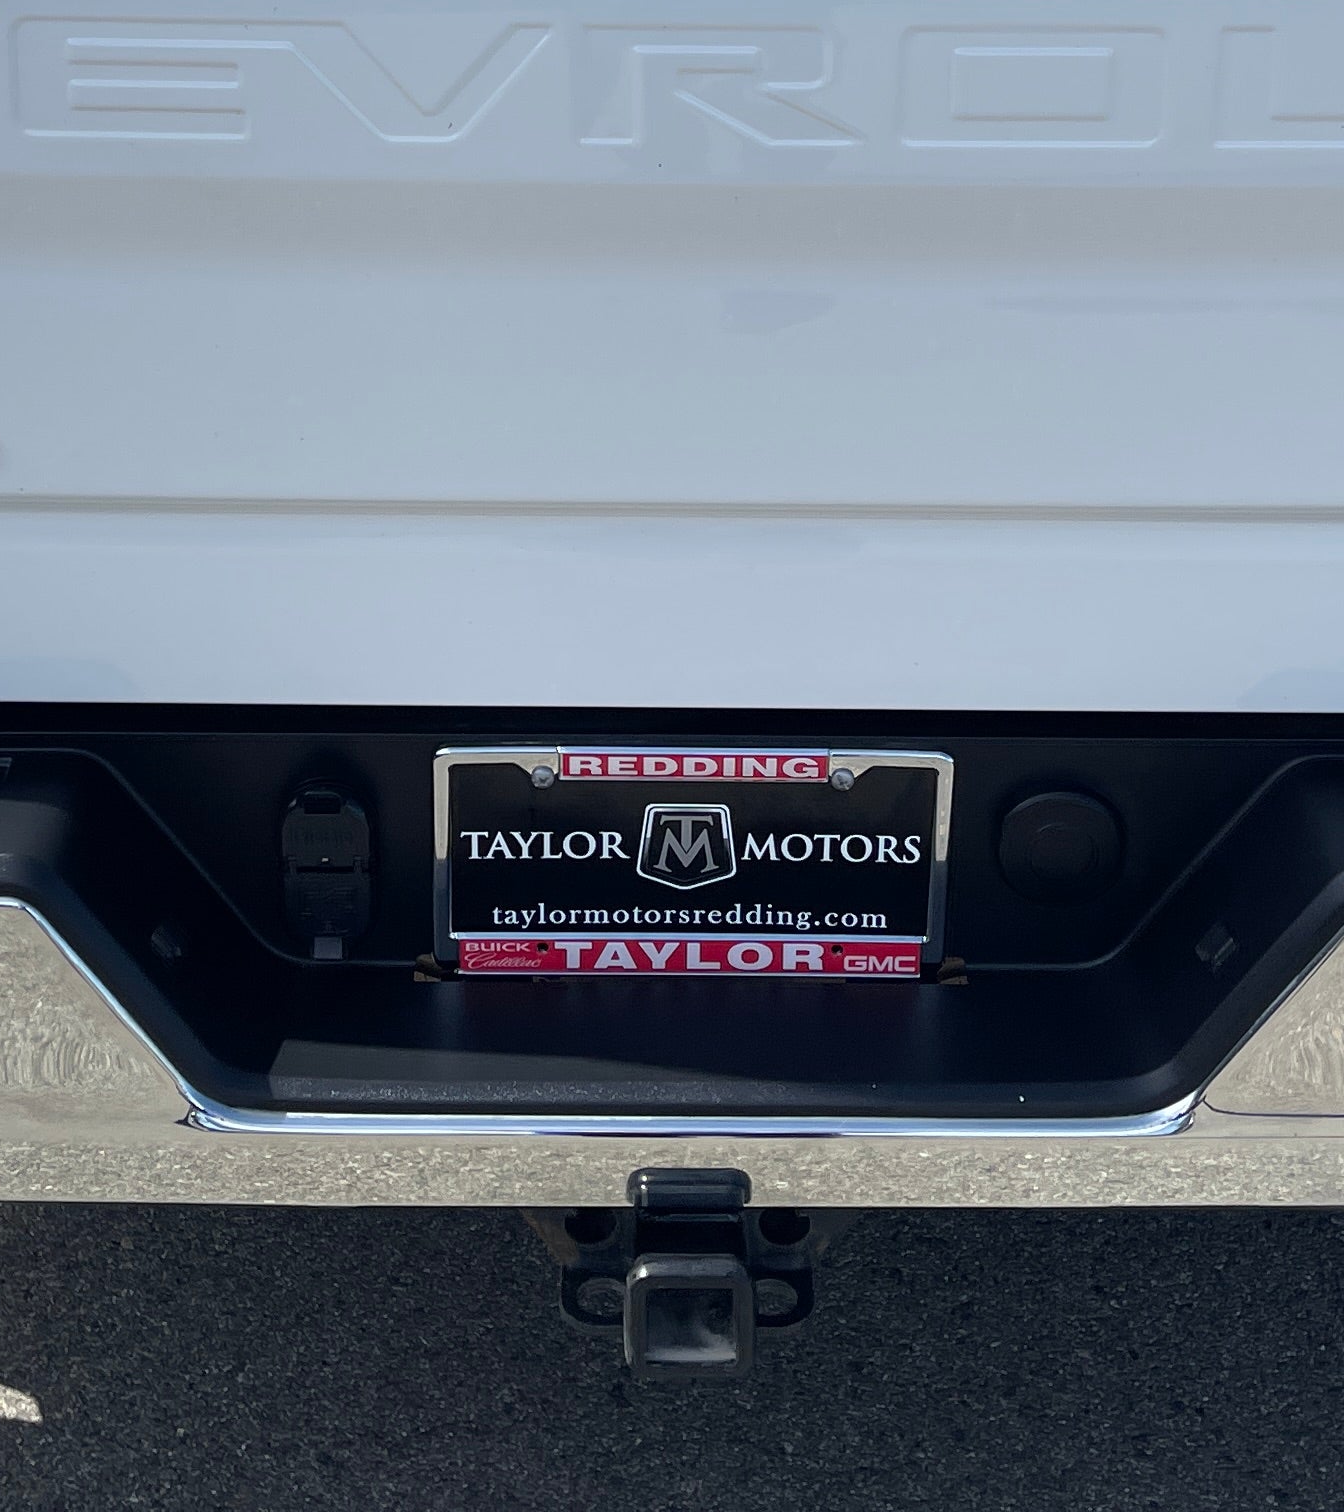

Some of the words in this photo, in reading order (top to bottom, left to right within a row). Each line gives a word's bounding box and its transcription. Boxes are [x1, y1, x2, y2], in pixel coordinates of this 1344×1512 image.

[568, 756, 822, 779] REDDING
[460, 831, 630, 860] TAYLOR
[741, 833, 921, 864] MOTORS
[492, 903, 888, 930] taylormotorsredding.com
[465, 942, 531, 952] BUICK
[554, 942, 824, 971] TAYLOR
[464, 952, 542, 969] Cadillac
[843, 955, 916, 973] GMC
